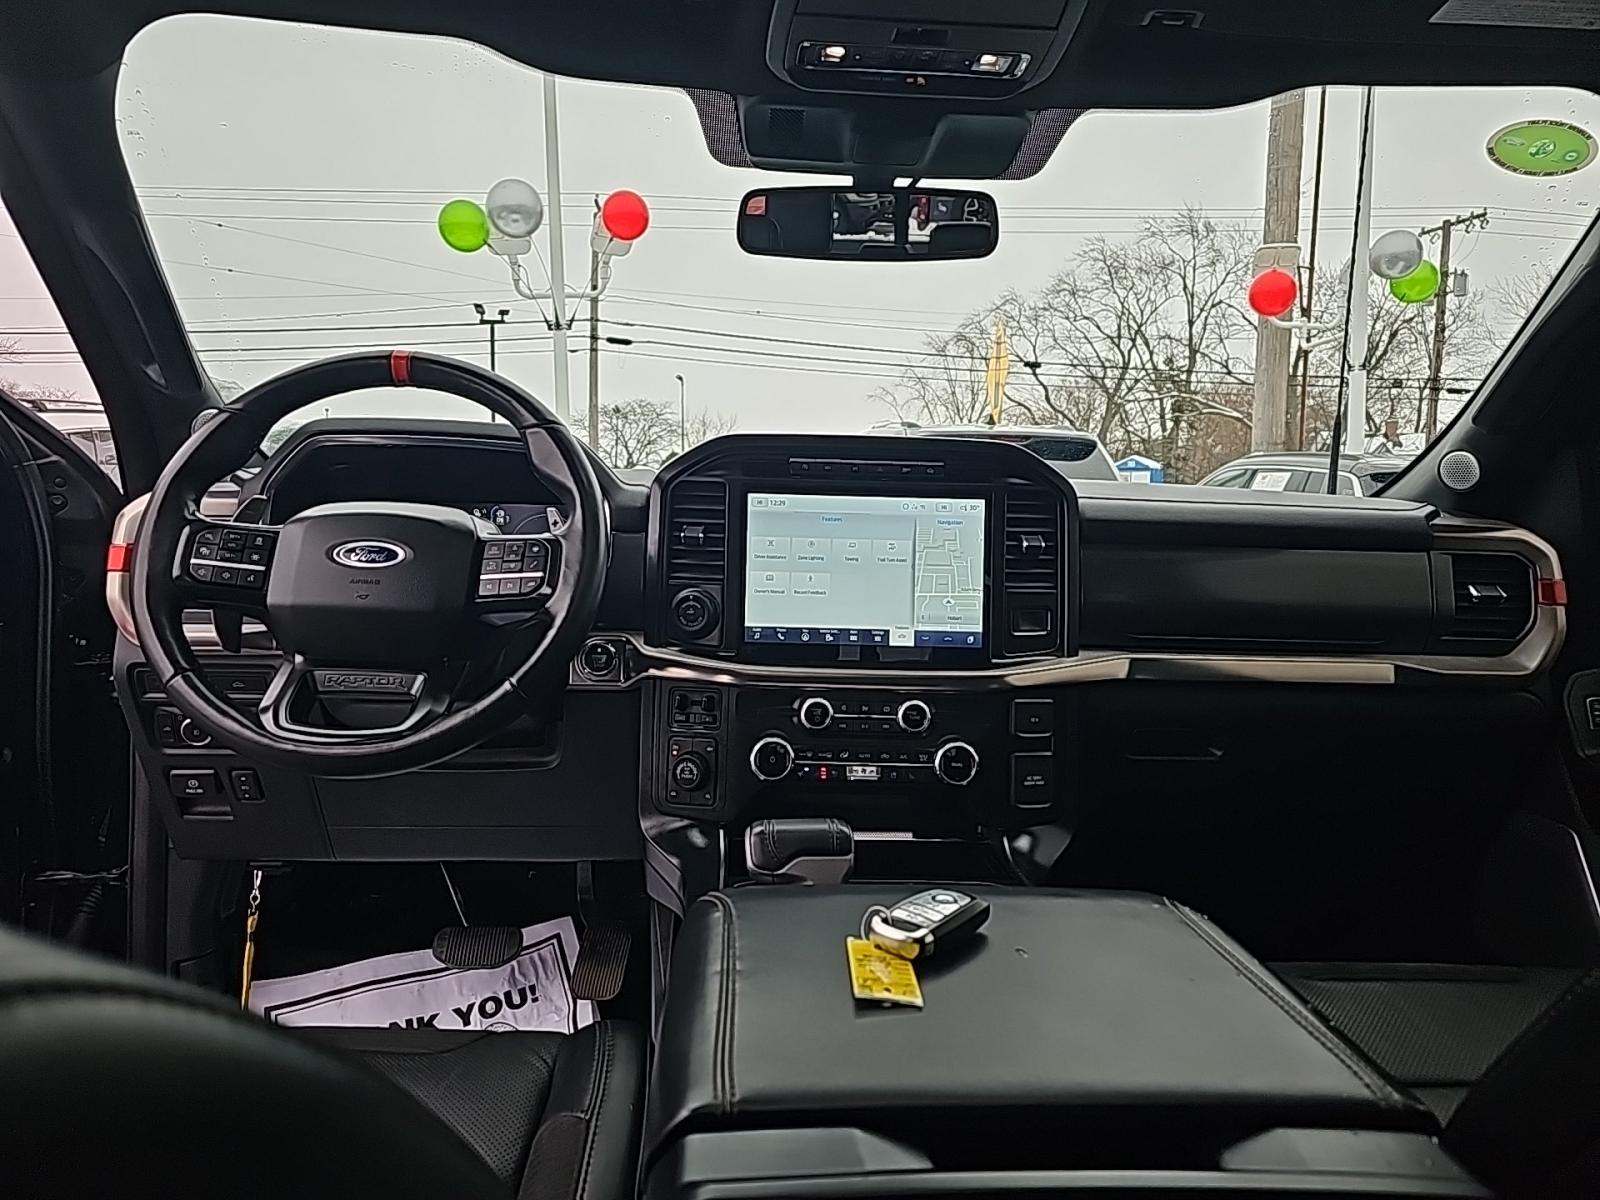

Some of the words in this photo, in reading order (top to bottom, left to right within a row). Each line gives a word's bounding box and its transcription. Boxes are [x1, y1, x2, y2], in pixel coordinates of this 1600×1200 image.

[350, 546, 388, 561] Ford
[324, 674, 408, 691] RAPTOR
[452, 984, 540, 1028] YOU!
